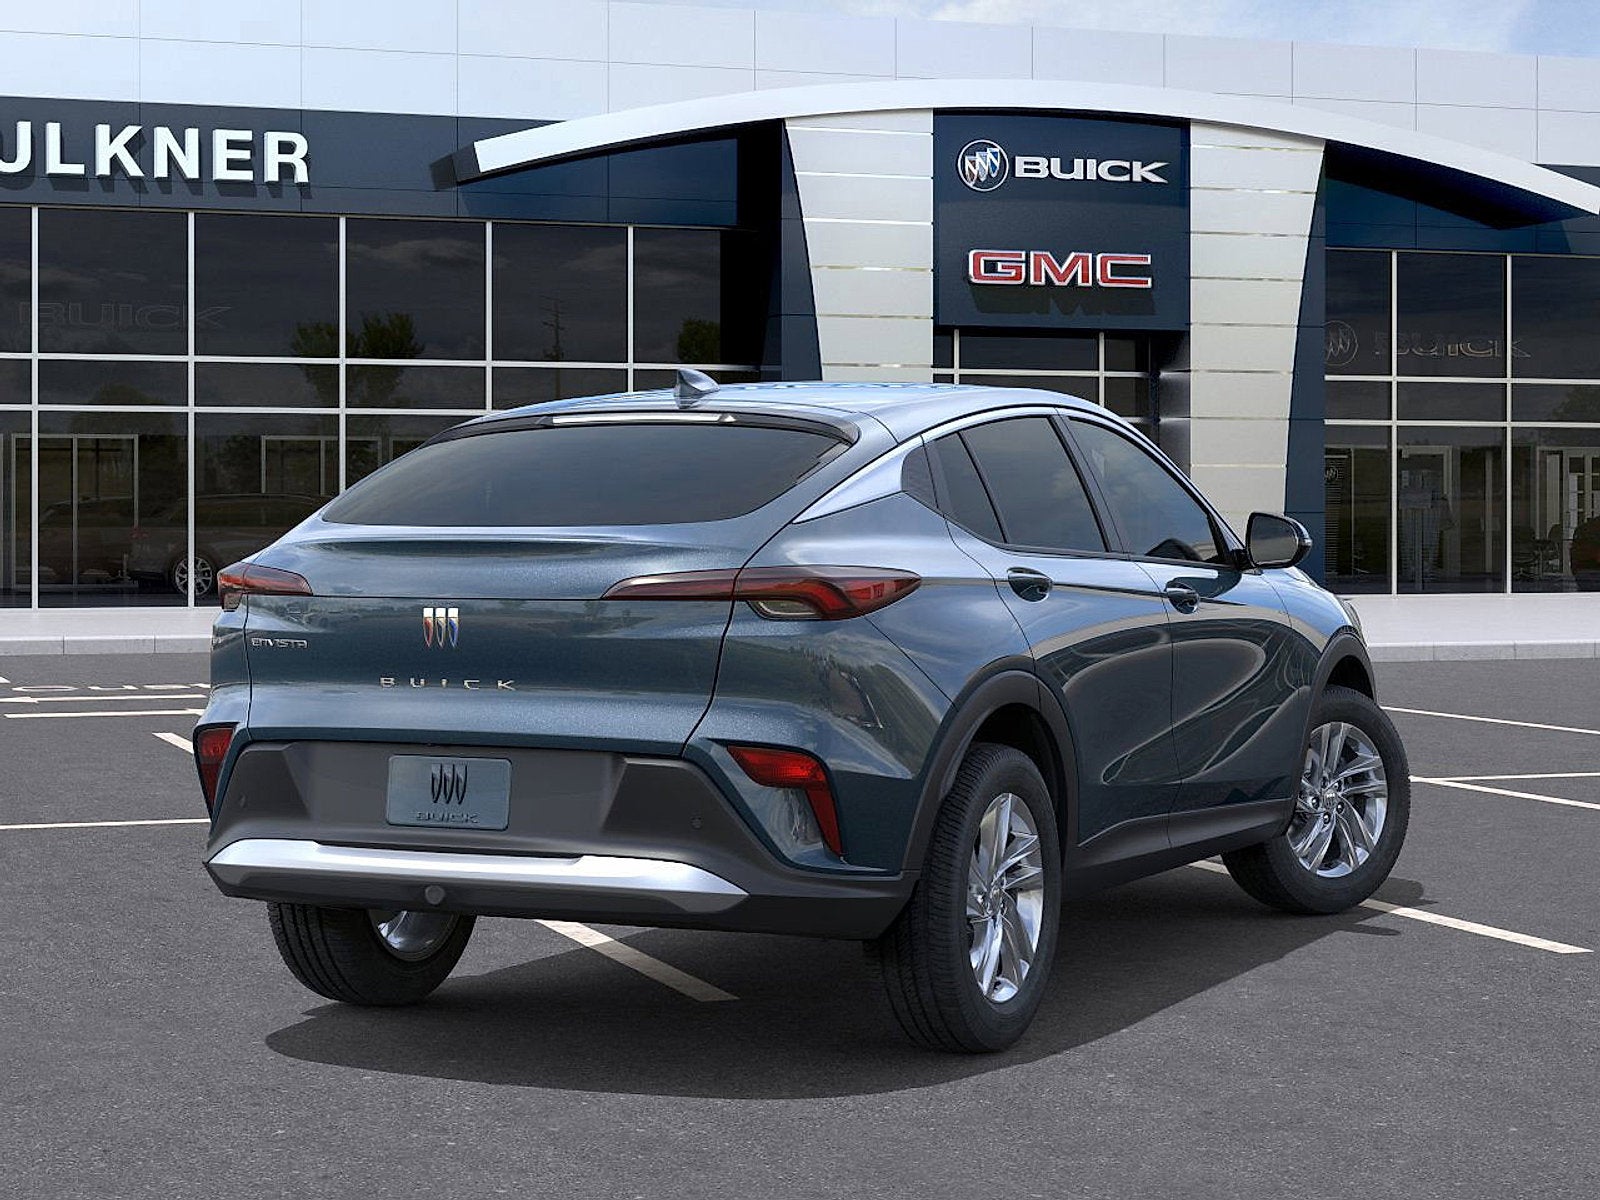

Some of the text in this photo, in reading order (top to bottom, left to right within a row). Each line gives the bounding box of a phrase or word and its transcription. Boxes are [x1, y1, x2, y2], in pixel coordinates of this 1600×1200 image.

[1014, 156, 1168, 184] BUICK
[968, 249, 1152, 288] GMC
[380, 677, 516, 691] BUICK
